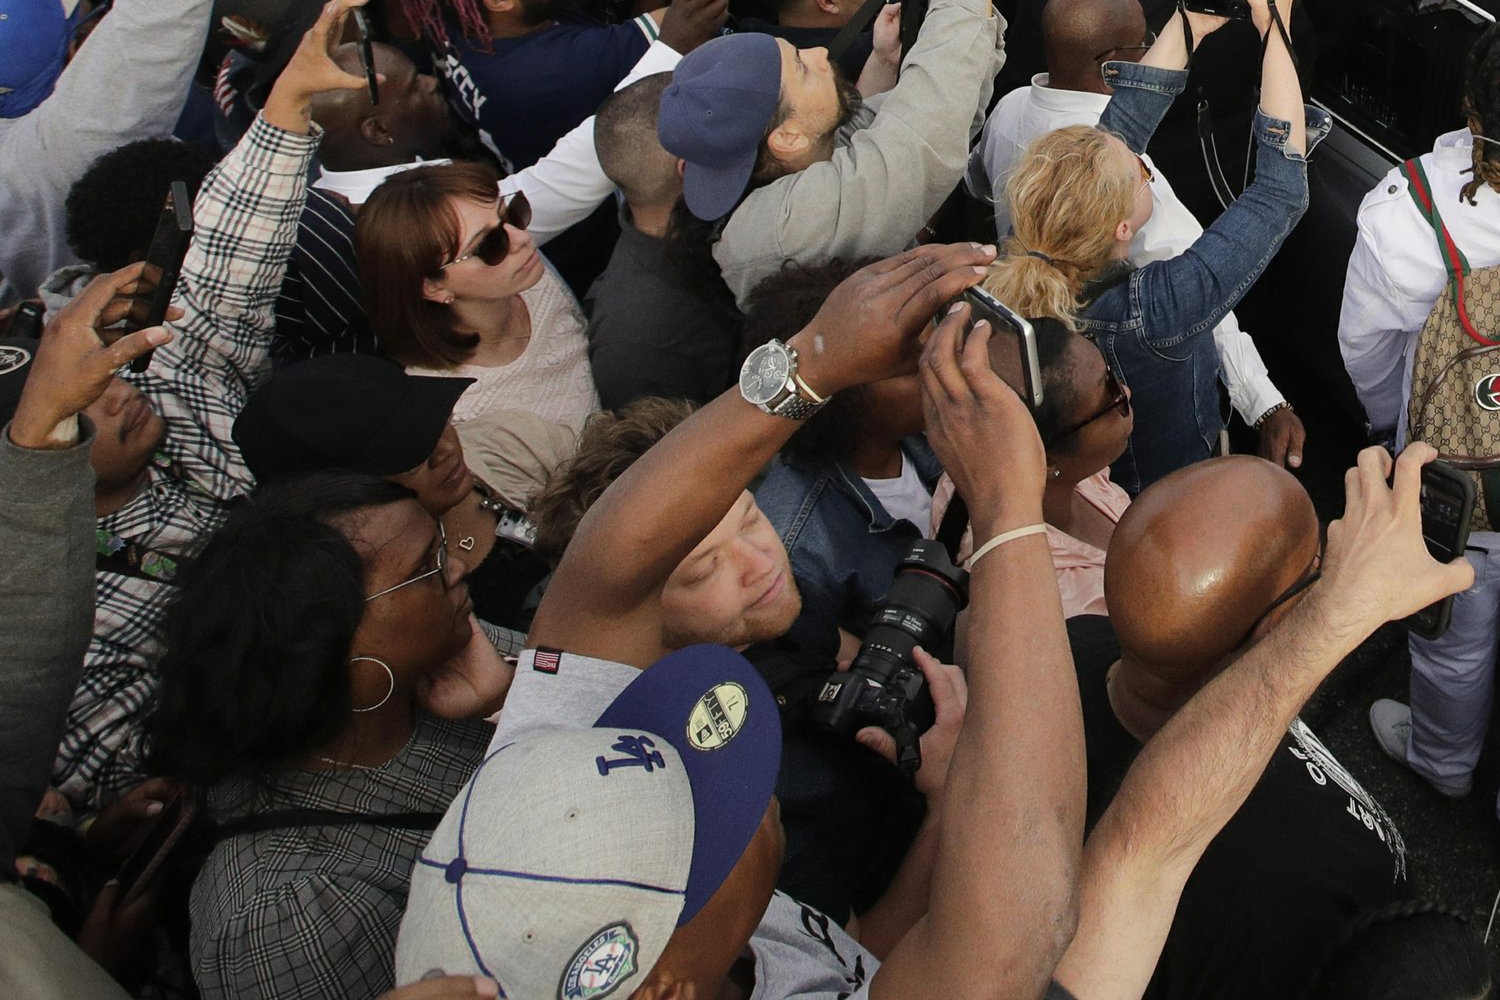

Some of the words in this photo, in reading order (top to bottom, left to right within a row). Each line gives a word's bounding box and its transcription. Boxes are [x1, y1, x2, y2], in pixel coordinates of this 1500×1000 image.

[595, 735, 666, 776] LA
[570, 935, 606, 975] ANGELES
[582, 953, 619, 976] LA
